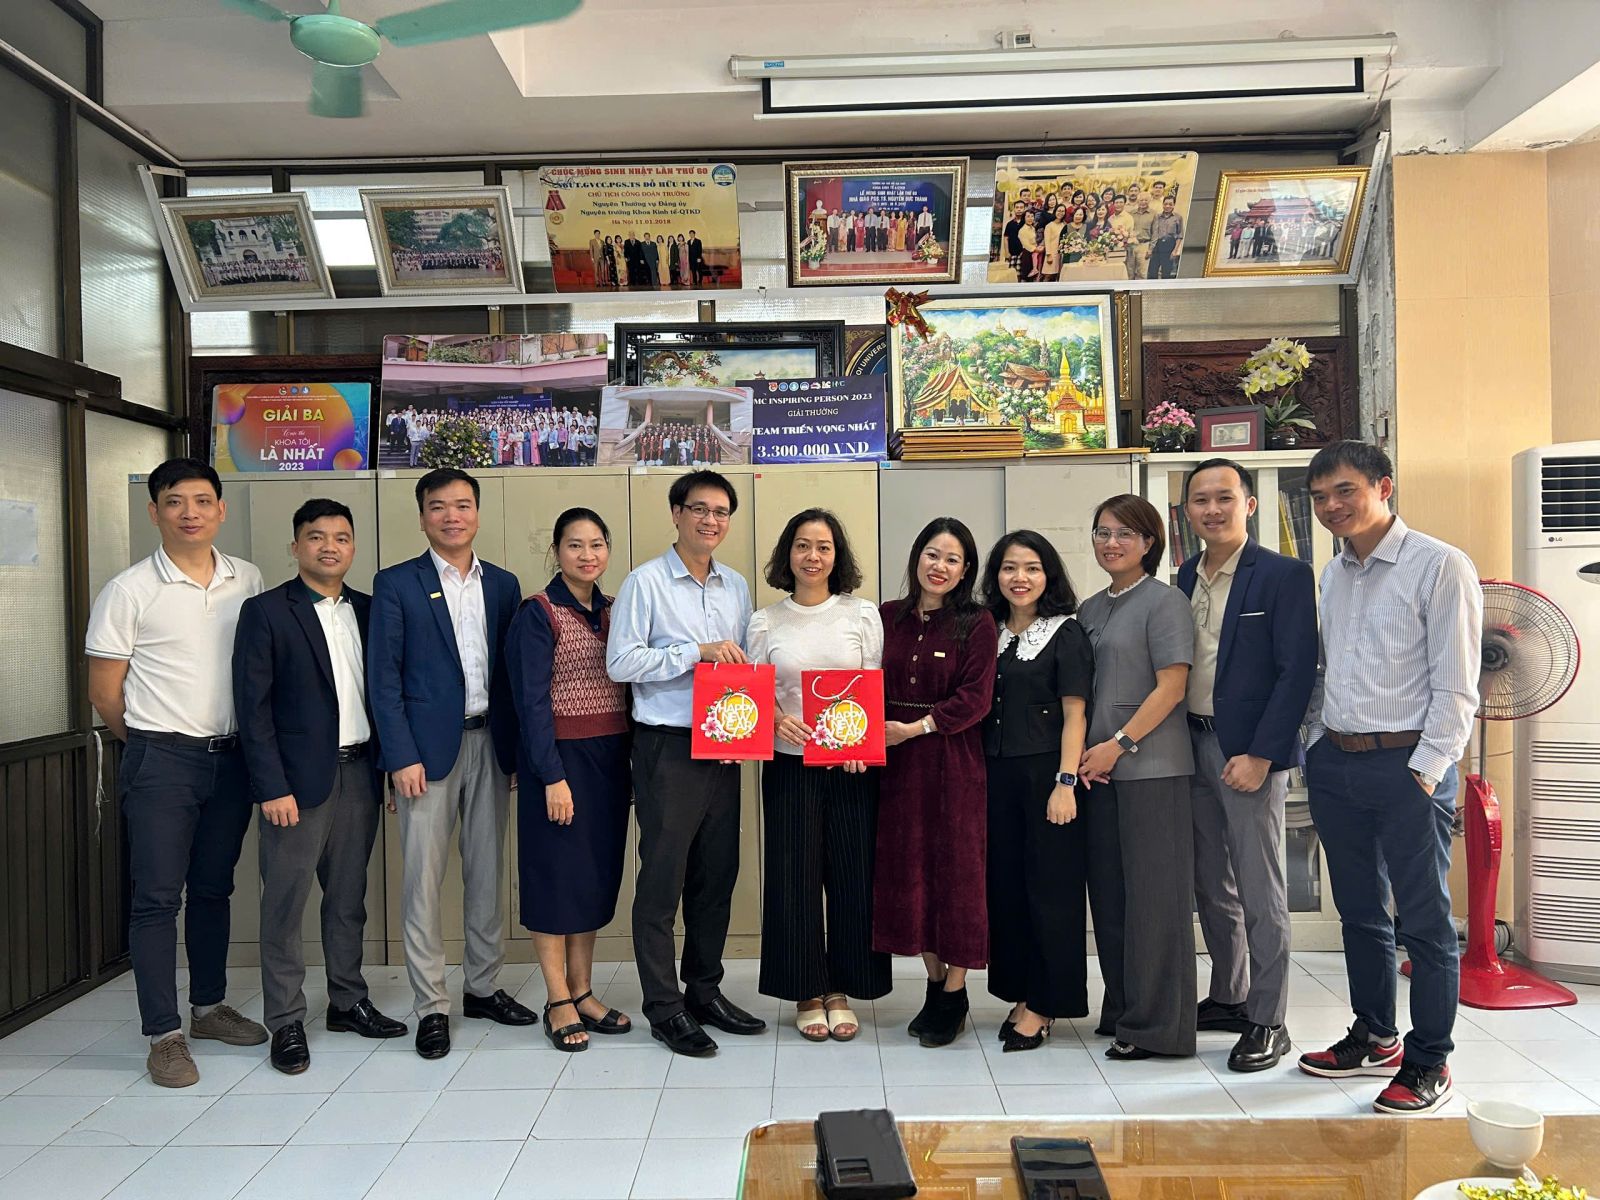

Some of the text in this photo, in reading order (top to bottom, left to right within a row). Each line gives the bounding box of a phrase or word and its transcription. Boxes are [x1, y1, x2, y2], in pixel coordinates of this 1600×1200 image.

[628, 167, 653, 176] NHẬT
[675, 166, 695, 175] THỨ
[769, 396, 812, 405] INSPIRING
[814, 394, 849, 403] PERSON
[850, 392, 873, 401] 2023
[263, 404, 325, 422] GIẢI BA
[787, 407, 839, 417] GIẢI THƯỜNG
[752, 427, 780, 436] TEAM
[816, 424, 846, 435] VỌNG
[847, 420, 877, 432] NHẤT
[274, 437, 311, 446] KHOA TÔI
[260, 443, 325, 461] LÀ NHẤT
[757, 443, 830, 458] 3.300.000
[279, 462, 304, 471] 2023
[718, 700, 756, 713] HAPPY
[827, 706, 864, 720] HAPPY
[721, 711, 751, 722] NEW
[831, 718, 860, 729] NEW
